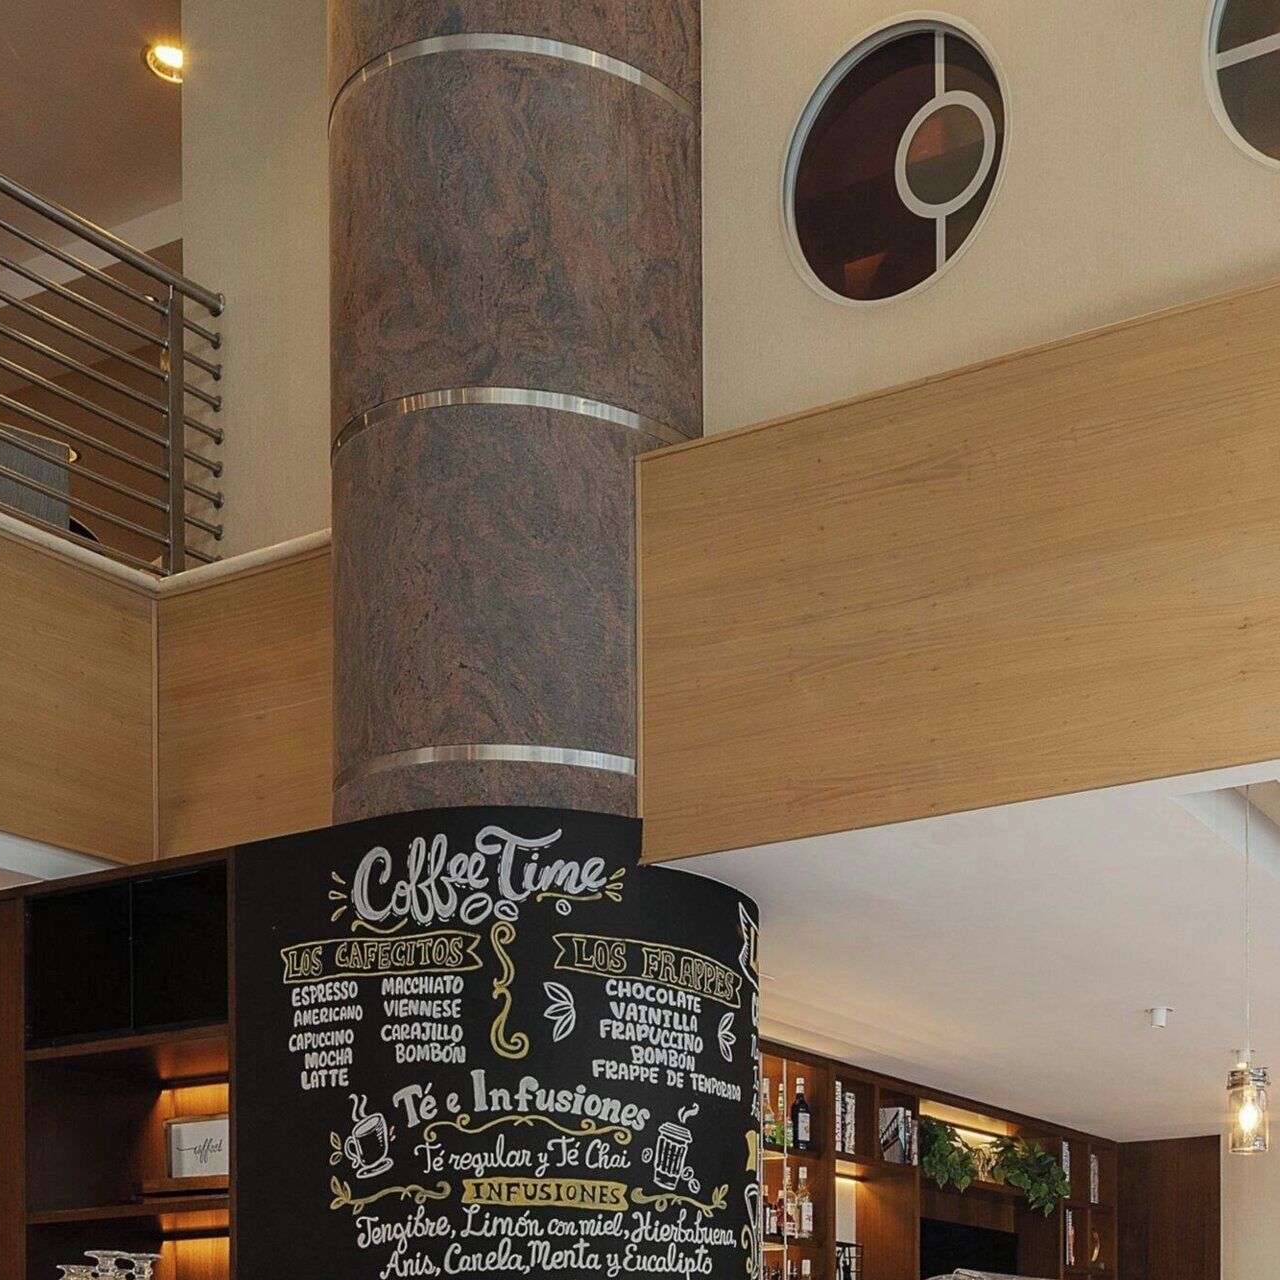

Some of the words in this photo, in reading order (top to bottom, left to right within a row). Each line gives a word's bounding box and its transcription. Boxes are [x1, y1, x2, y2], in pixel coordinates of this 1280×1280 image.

[351, 833, 490, 924] Coffee
[475, 825, 608, 901] Time
[287, 946, 323, 977] LOS
[335, 937, 464, 970] CAFECITOS
[572, 938, 627, 972] LOS
[641, 946, 735, 1000] FRAPPES
[291, 980, 359, 1007] ESPRESSO
[381, 975, 464, 996] MACCHIATO
[605, 978, 702, 1014] CHOCOLATE
[293, 1005, 363, 1028] AMERICANO
[383, 998, 462, 1019] VIENNESE
[609, 1001, 699, 1033] VAINILLA
[288, 1028, 355, 1053] CAPUCCINO
[380, 1022, 464, 1043] CARAJILLO
[599, 1018, 704, 1054] FRAPUCCINO
[304, 1047, 353, 1070] MOCHA
[395, 1042, 467, 1064] BOMBÓN
[630, 1045, 696, 1072] BOMBÓN
[300, 1067, 350, 1090] LATTE
[592, 1058, 660, 1085] FRAPPE
[666, 1069, 685, 1089] DE
[689, 1072, 742, 1102] TEMPORADA
[392, 1082, 439, 1129] Té
[446, 1091, 462, 1114] e
[470, 1068, 651, 1131] Infusiones
[414, 1140, 444, 1174] Té
[449, 1133, 533, 1177] regular
[537, 1152, 550, 1178] y
[547, 1136, 579, 1169] Té
[585, 1138, 632, 1169] Chai
[472, 1182, 621, 1205] INFUSIONES
[460, 1203, 545, 1238] Limón
[547, 1217, 578, 1237] con
[578, 1212, 630, 1241] miel,
[631, 1208, 738, 1249] Hierbabuena,
[443, 1236, 531, 1275] Canela,
[528, 1237, 603, 1271] Menta
[606, 1251, 622, 1278] y
